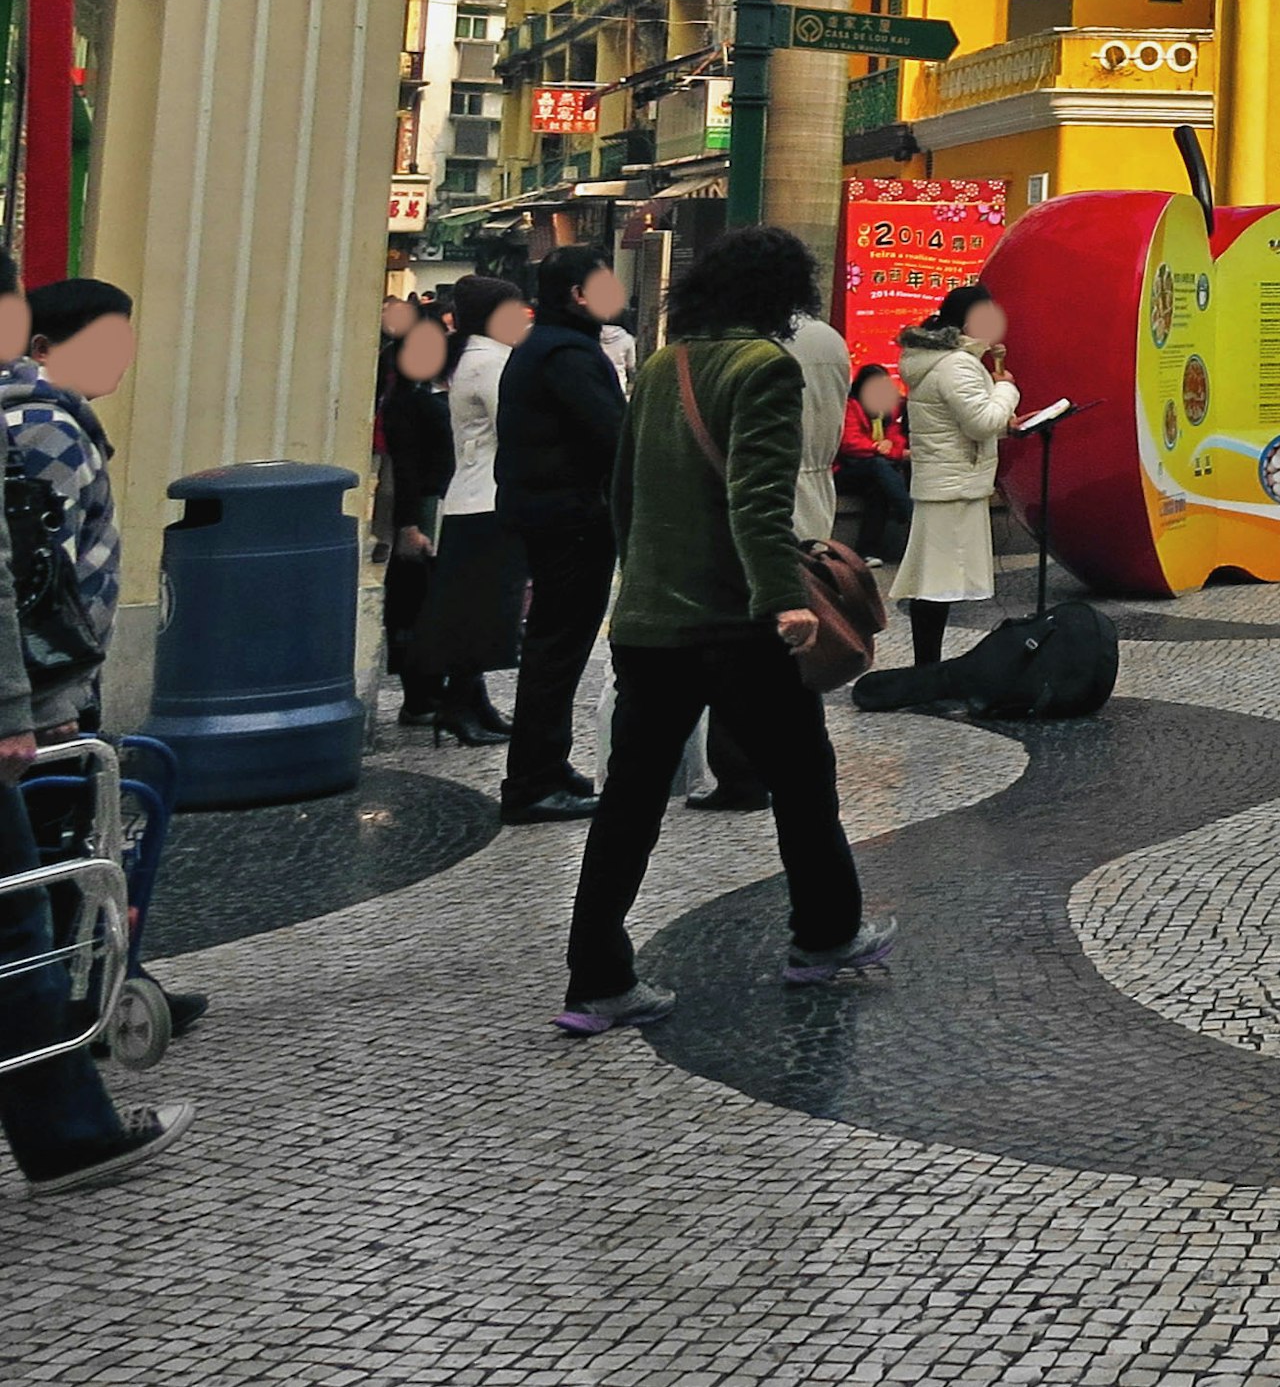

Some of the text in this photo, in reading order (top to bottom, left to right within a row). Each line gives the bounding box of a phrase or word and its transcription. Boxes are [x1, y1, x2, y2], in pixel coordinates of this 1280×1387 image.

[824, 29, 912, 46] CASA DE LOU KAU
[873, 221, 946, 251] 2014
[869, 251, 896, 259] Feira
[943, 265, 963, 273] 2014
[870, 290, 895, 300] 2014
